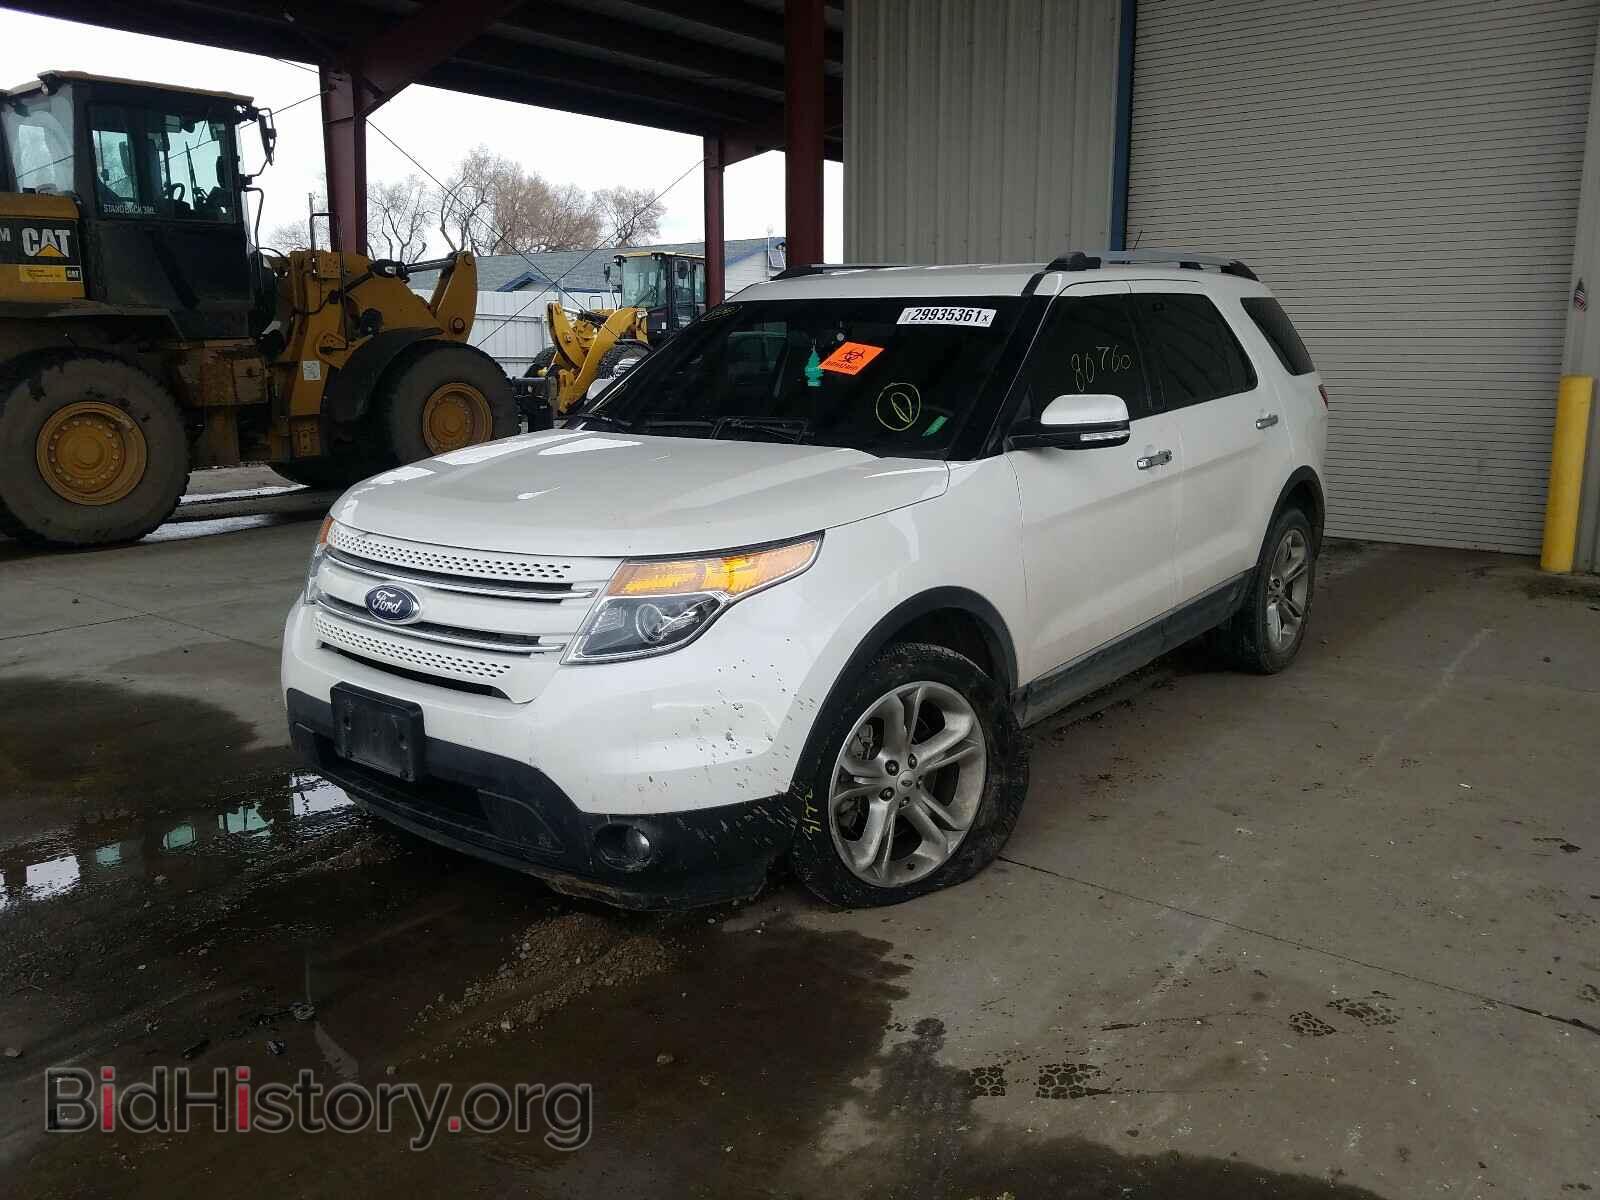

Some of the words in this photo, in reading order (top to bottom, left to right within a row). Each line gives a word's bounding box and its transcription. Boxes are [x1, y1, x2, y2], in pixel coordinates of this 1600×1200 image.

[22, 227, 70, 258] CAT
[66, 270, 80, 279] CAT
[910, 308, 982, 322] 29935361
[372, 590, 403, 614] Ford
